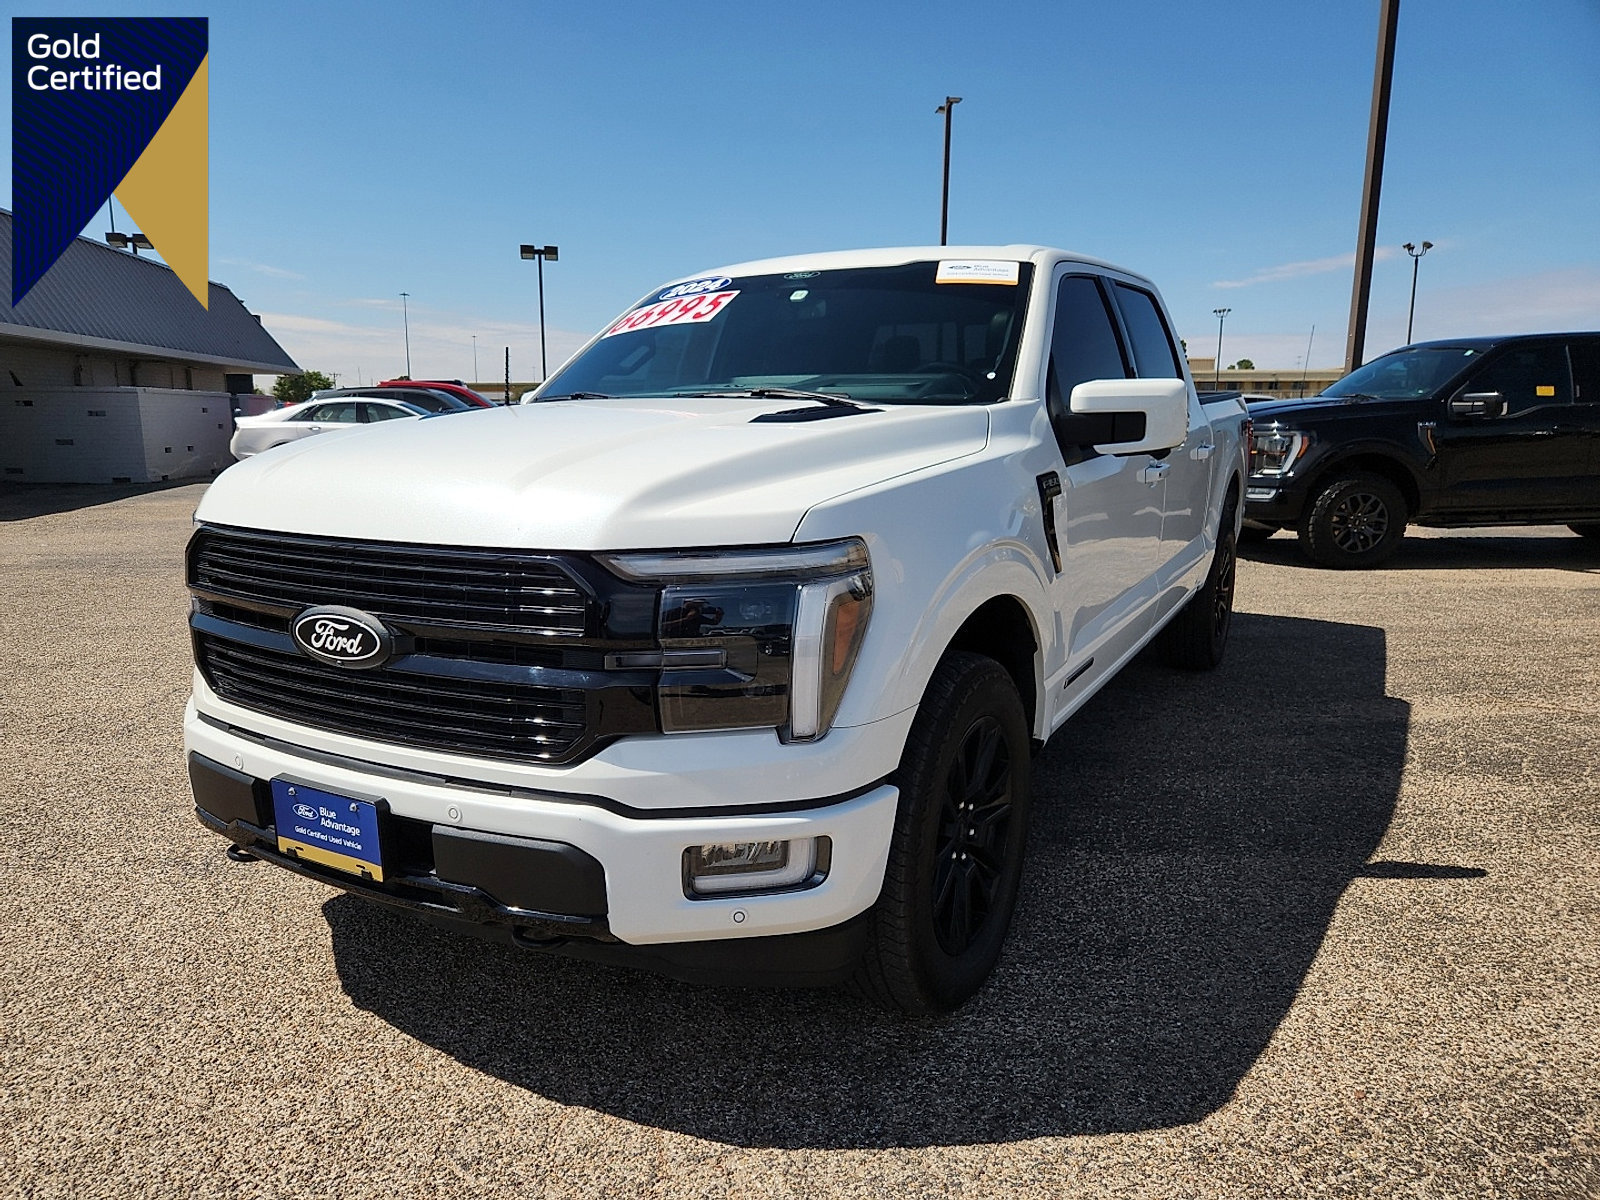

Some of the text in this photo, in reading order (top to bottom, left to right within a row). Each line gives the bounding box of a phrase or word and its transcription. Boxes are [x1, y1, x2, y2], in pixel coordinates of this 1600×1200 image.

[669, 279, 724, 297] 2024
[609, 292, 735, 334] 66995
[311, 620, 363, 655] Ford
[297, 805, 314, 818] Ford
[319, 807, 337, 819] Blue
[320, 818, 361, 837] Advantage
[294, 825, 362, 850] Gold Certified Used Vehicle
